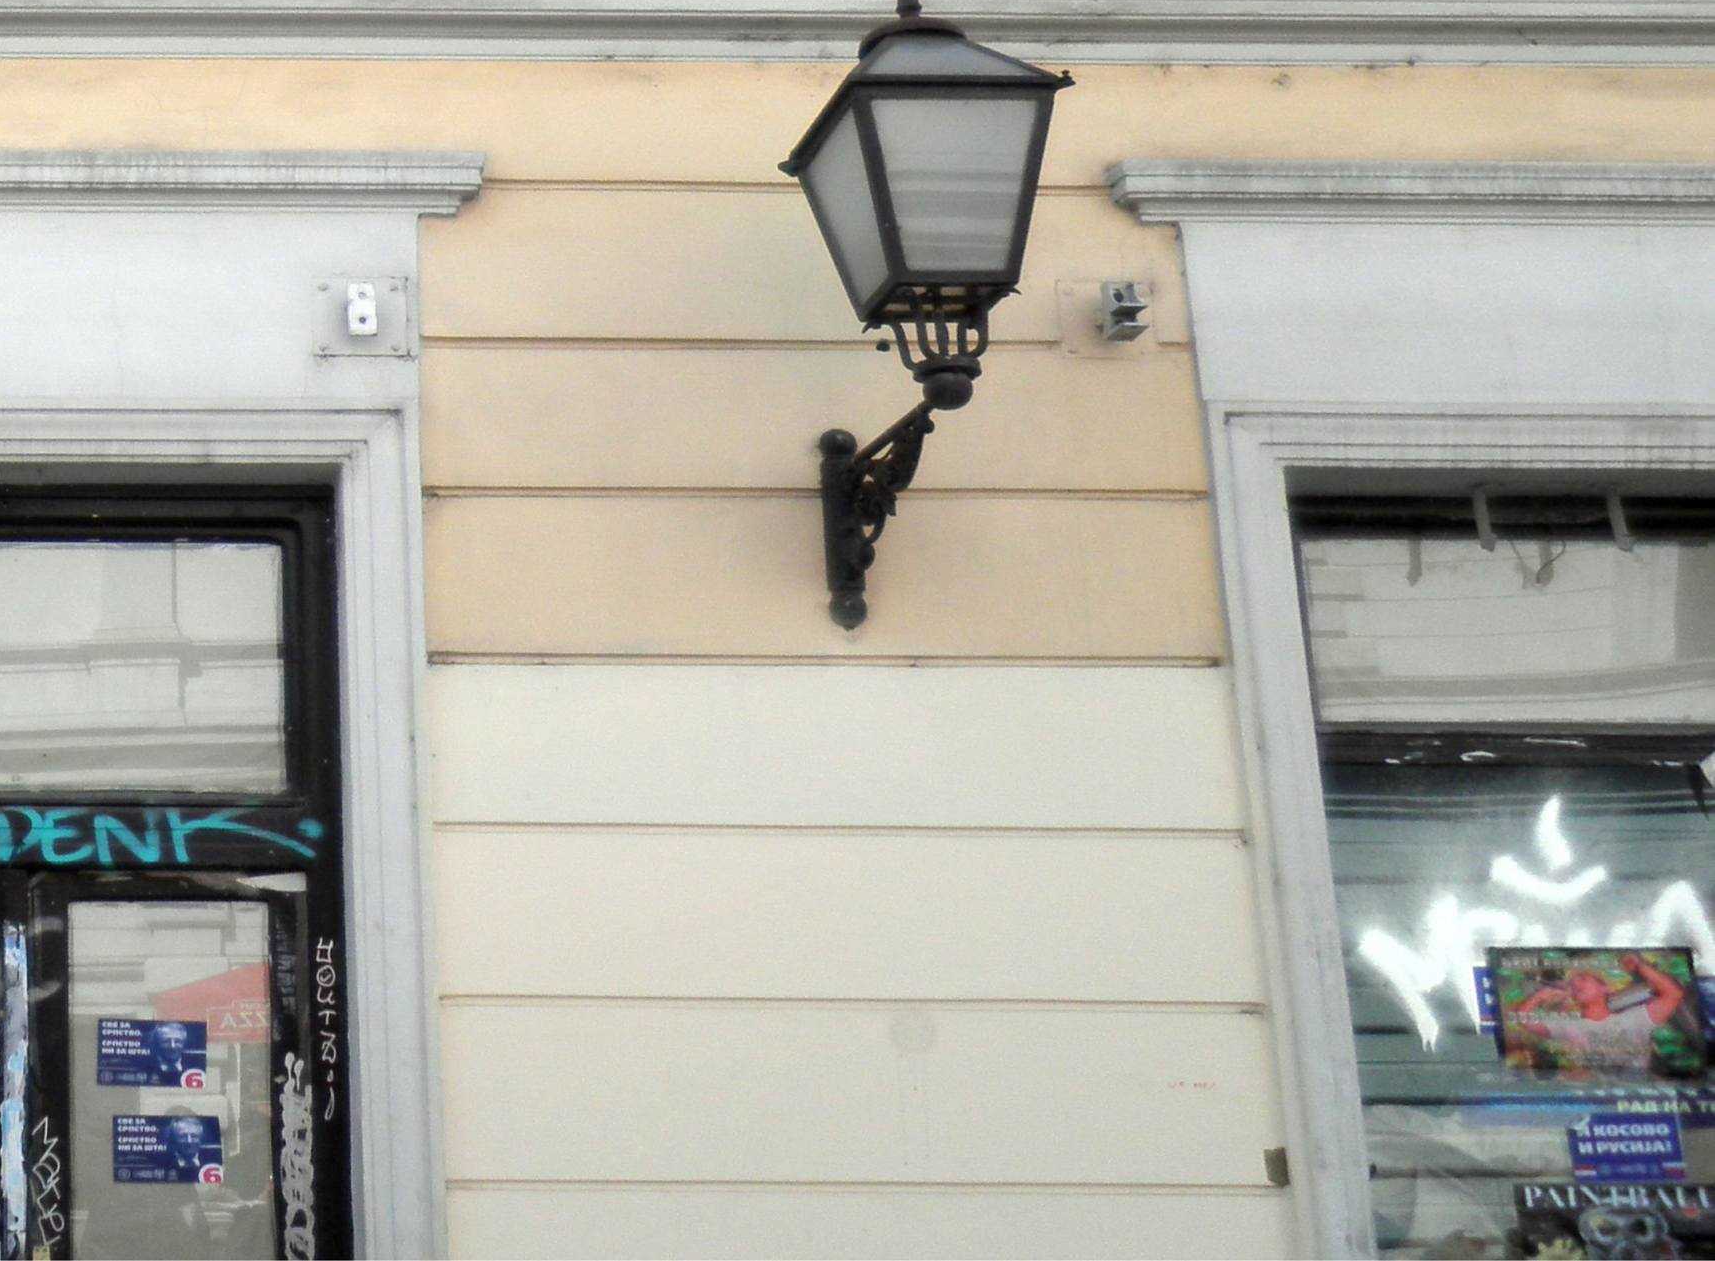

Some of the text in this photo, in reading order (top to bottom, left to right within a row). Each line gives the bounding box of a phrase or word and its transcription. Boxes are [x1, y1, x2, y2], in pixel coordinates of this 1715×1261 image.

[1592, 1123, 1670, 1137] КОСОВО
[1578, 1139, 1673, 1155] И РУСИЈА!
